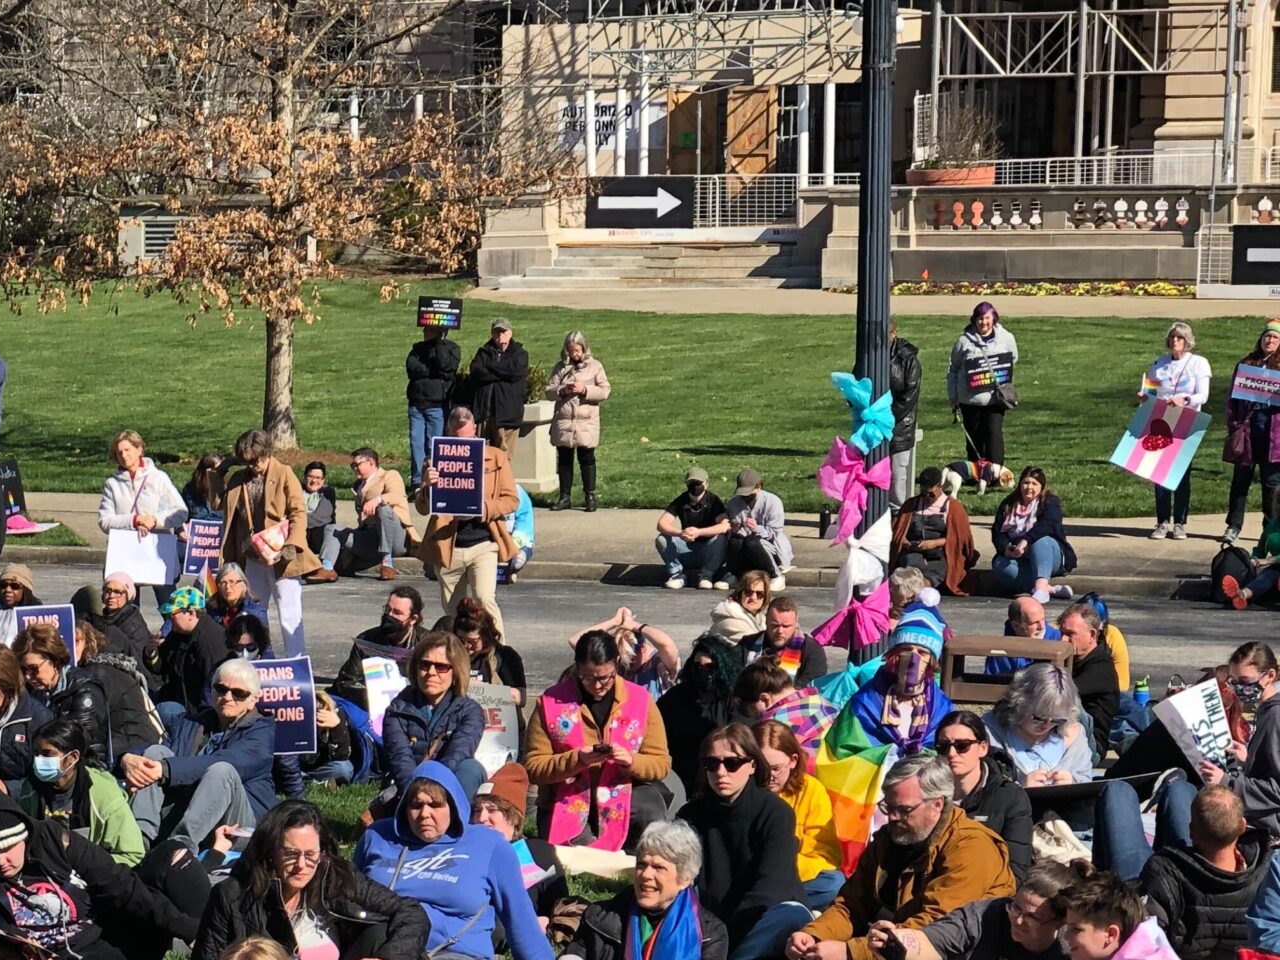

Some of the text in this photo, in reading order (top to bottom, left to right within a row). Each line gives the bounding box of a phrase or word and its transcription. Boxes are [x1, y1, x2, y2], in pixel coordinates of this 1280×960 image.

[563, 104, 632, 118] AUTORIZD
[438, 444, 471, 457] TRANS
[438, 461, 473, 473] PEOPLE
[437, 477, 475, 490] BELONG
[194, 525, 220, 535] TRANS
[193, 536, 221, 546] PEOPLE
[1201, 683, 1226, 728] THEM!
